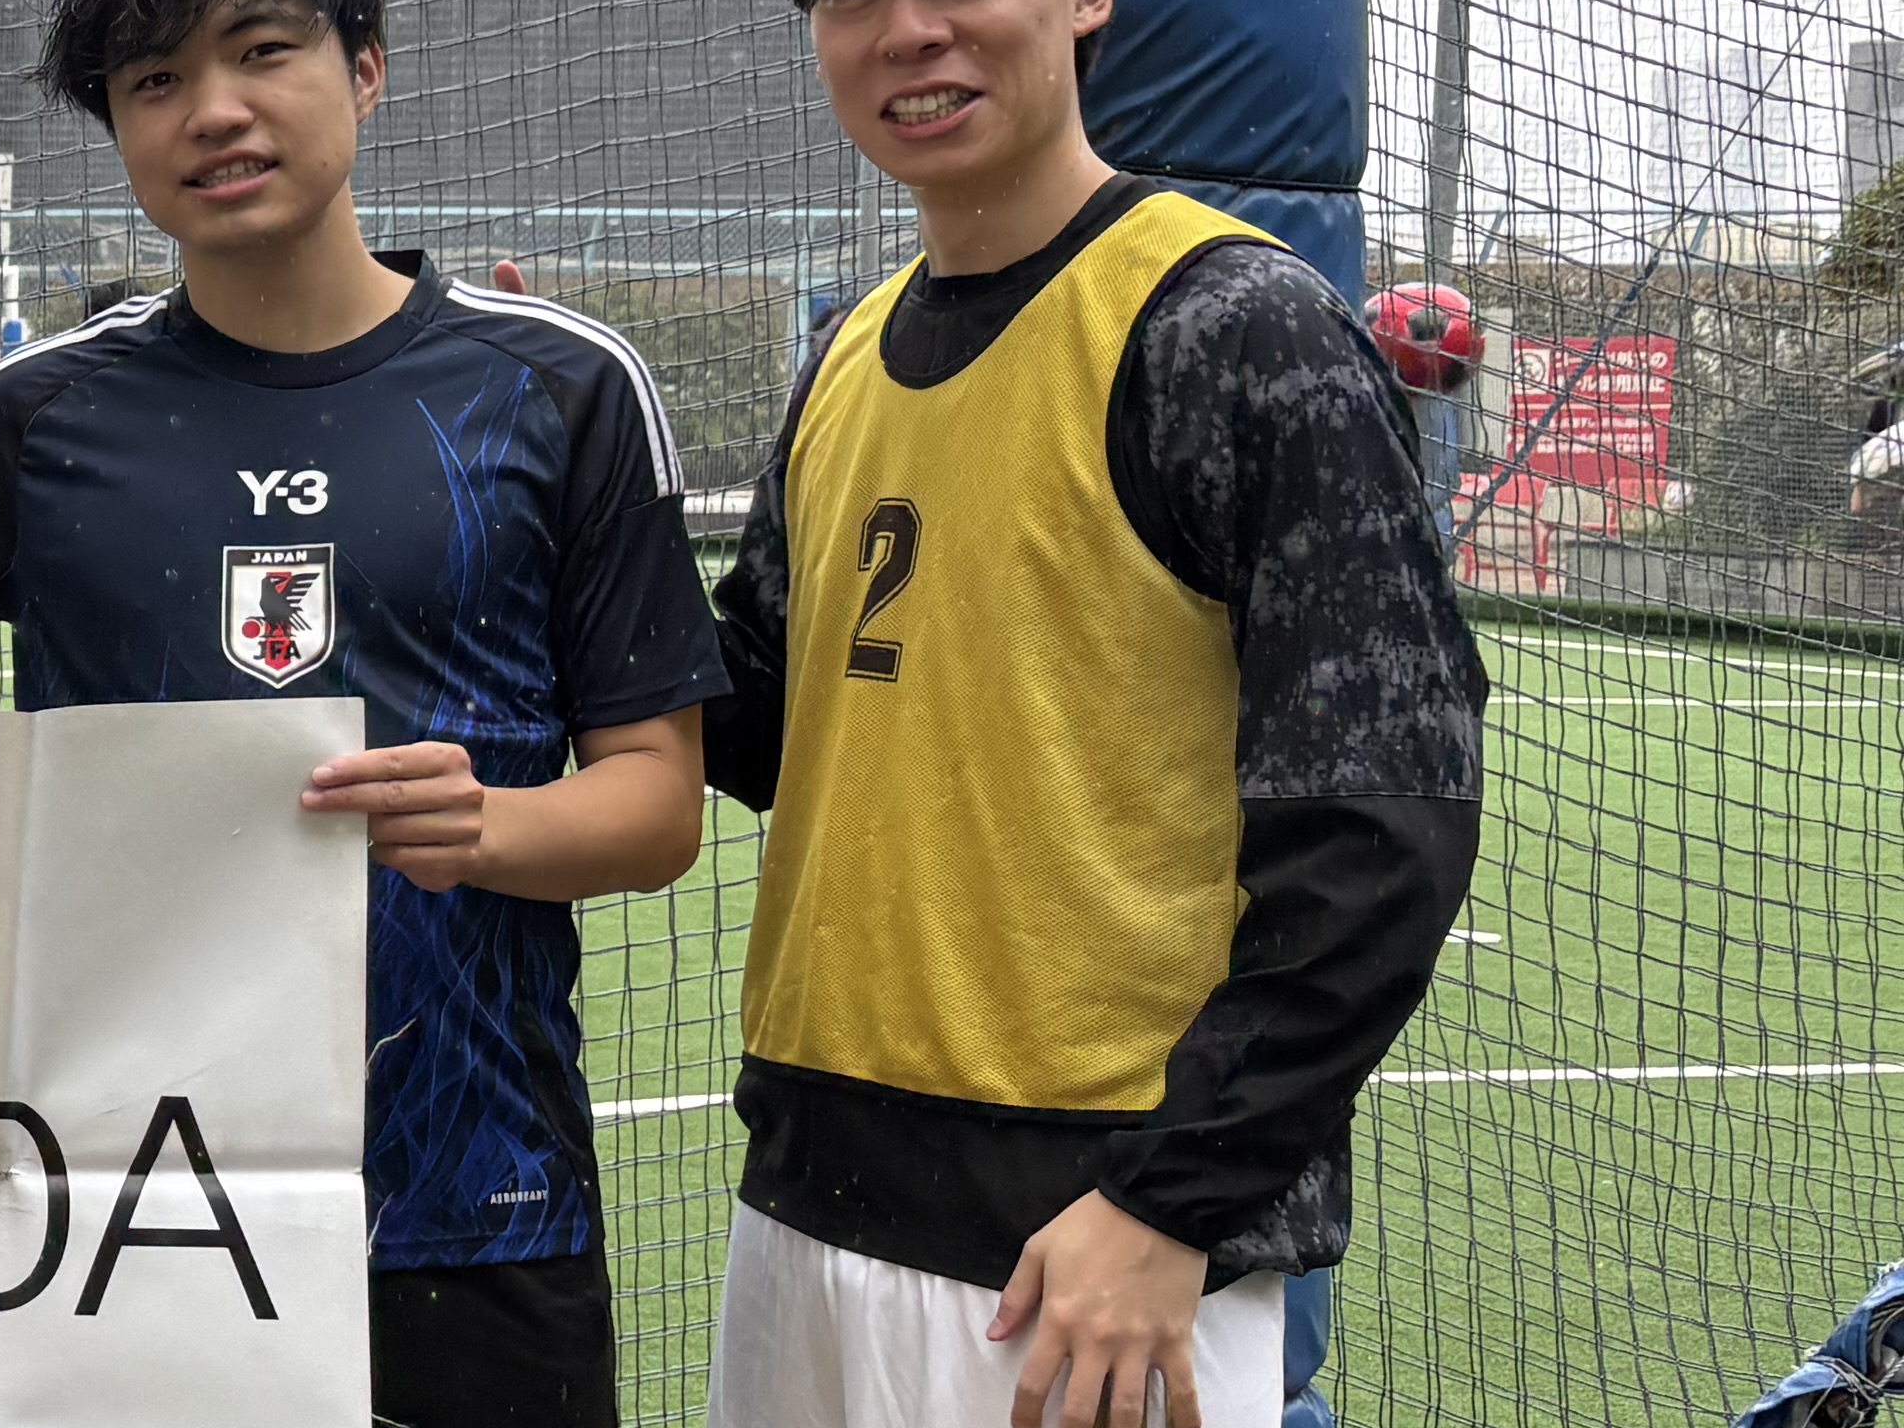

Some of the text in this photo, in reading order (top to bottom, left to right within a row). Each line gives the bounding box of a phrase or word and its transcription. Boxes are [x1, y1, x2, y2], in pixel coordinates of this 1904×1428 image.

[236, 469, 330, 516] Y-3
[251, 549, 308, 564] JAPAN
[845, 497, 923, 683] 2
[253, 640, 302, 661] JFA
